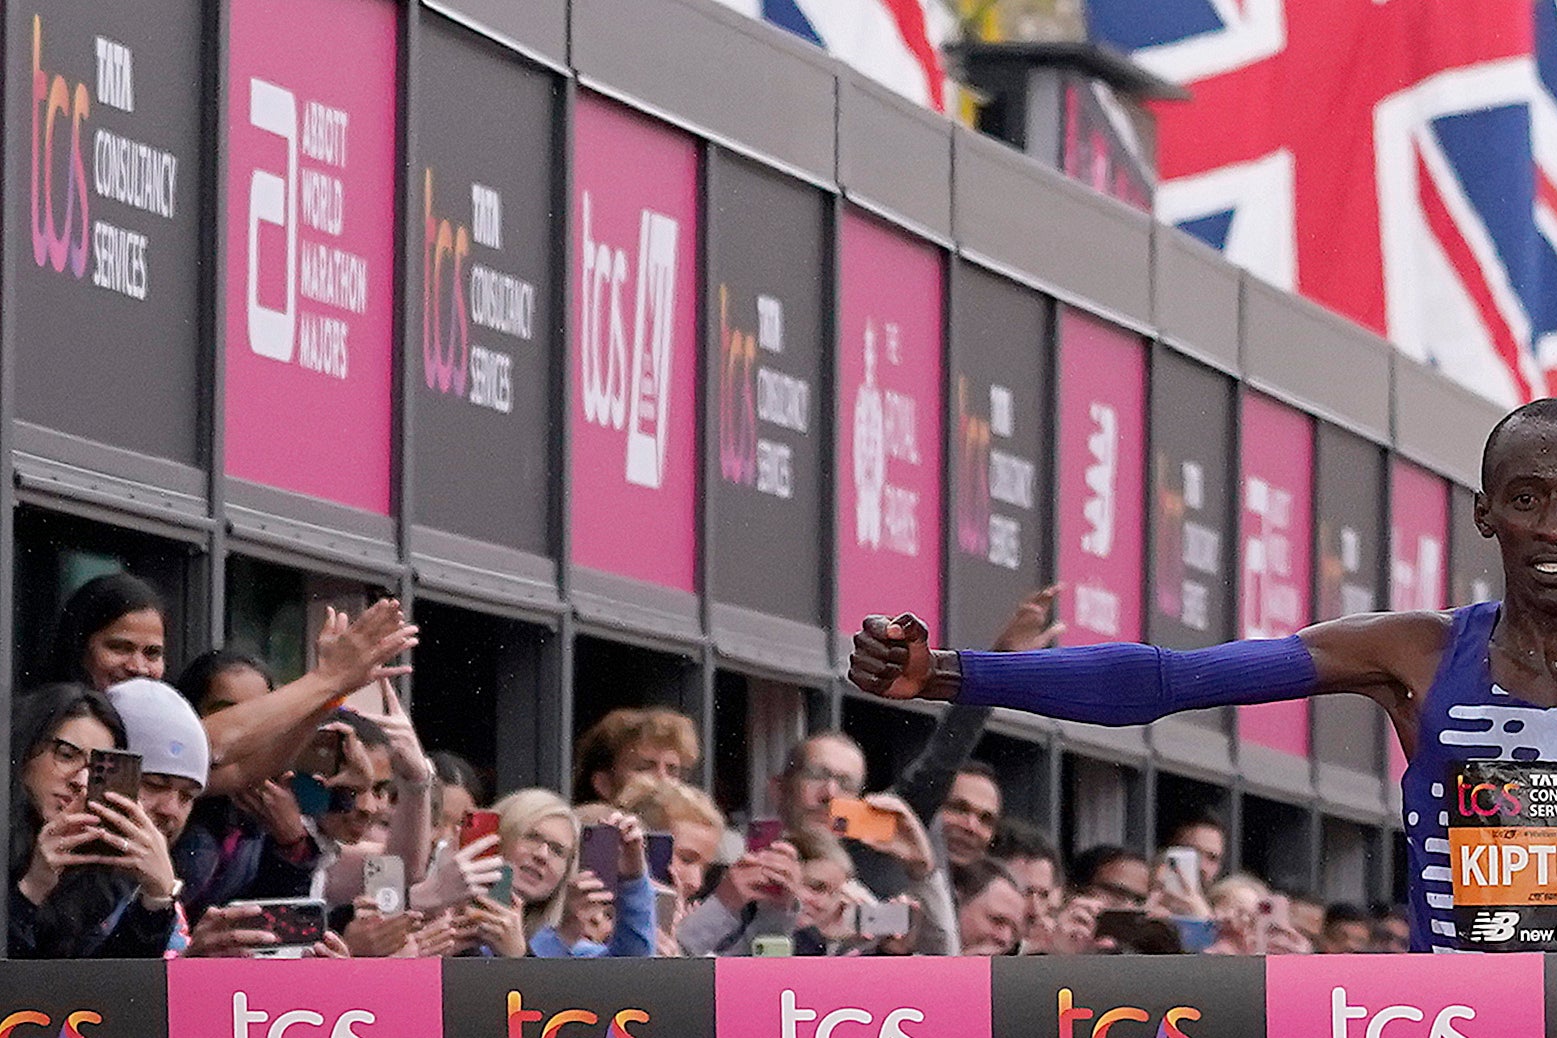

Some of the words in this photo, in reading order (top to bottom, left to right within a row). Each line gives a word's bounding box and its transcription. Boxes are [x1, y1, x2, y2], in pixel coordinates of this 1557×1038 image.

[95, 35, 134, 113] TATA
[32, 13, 90, 279] tcs
[93, 127, 178, 219] CONSULTANCY
[302, 100, 349, 169] ABBOTT
[301, 166, 344, 237] WORLD
[93, 219, 150, 301] SERVICES
[300, 238, 368, 317] MARATHON
[423, 166, 469, 397] tcs
[299, 312, 348, 381] MAJORS
[582, 190, 628, 431] tcs
[1457, 774, 1523, 816] tcs
[1520, 928, 1555, 942] new
